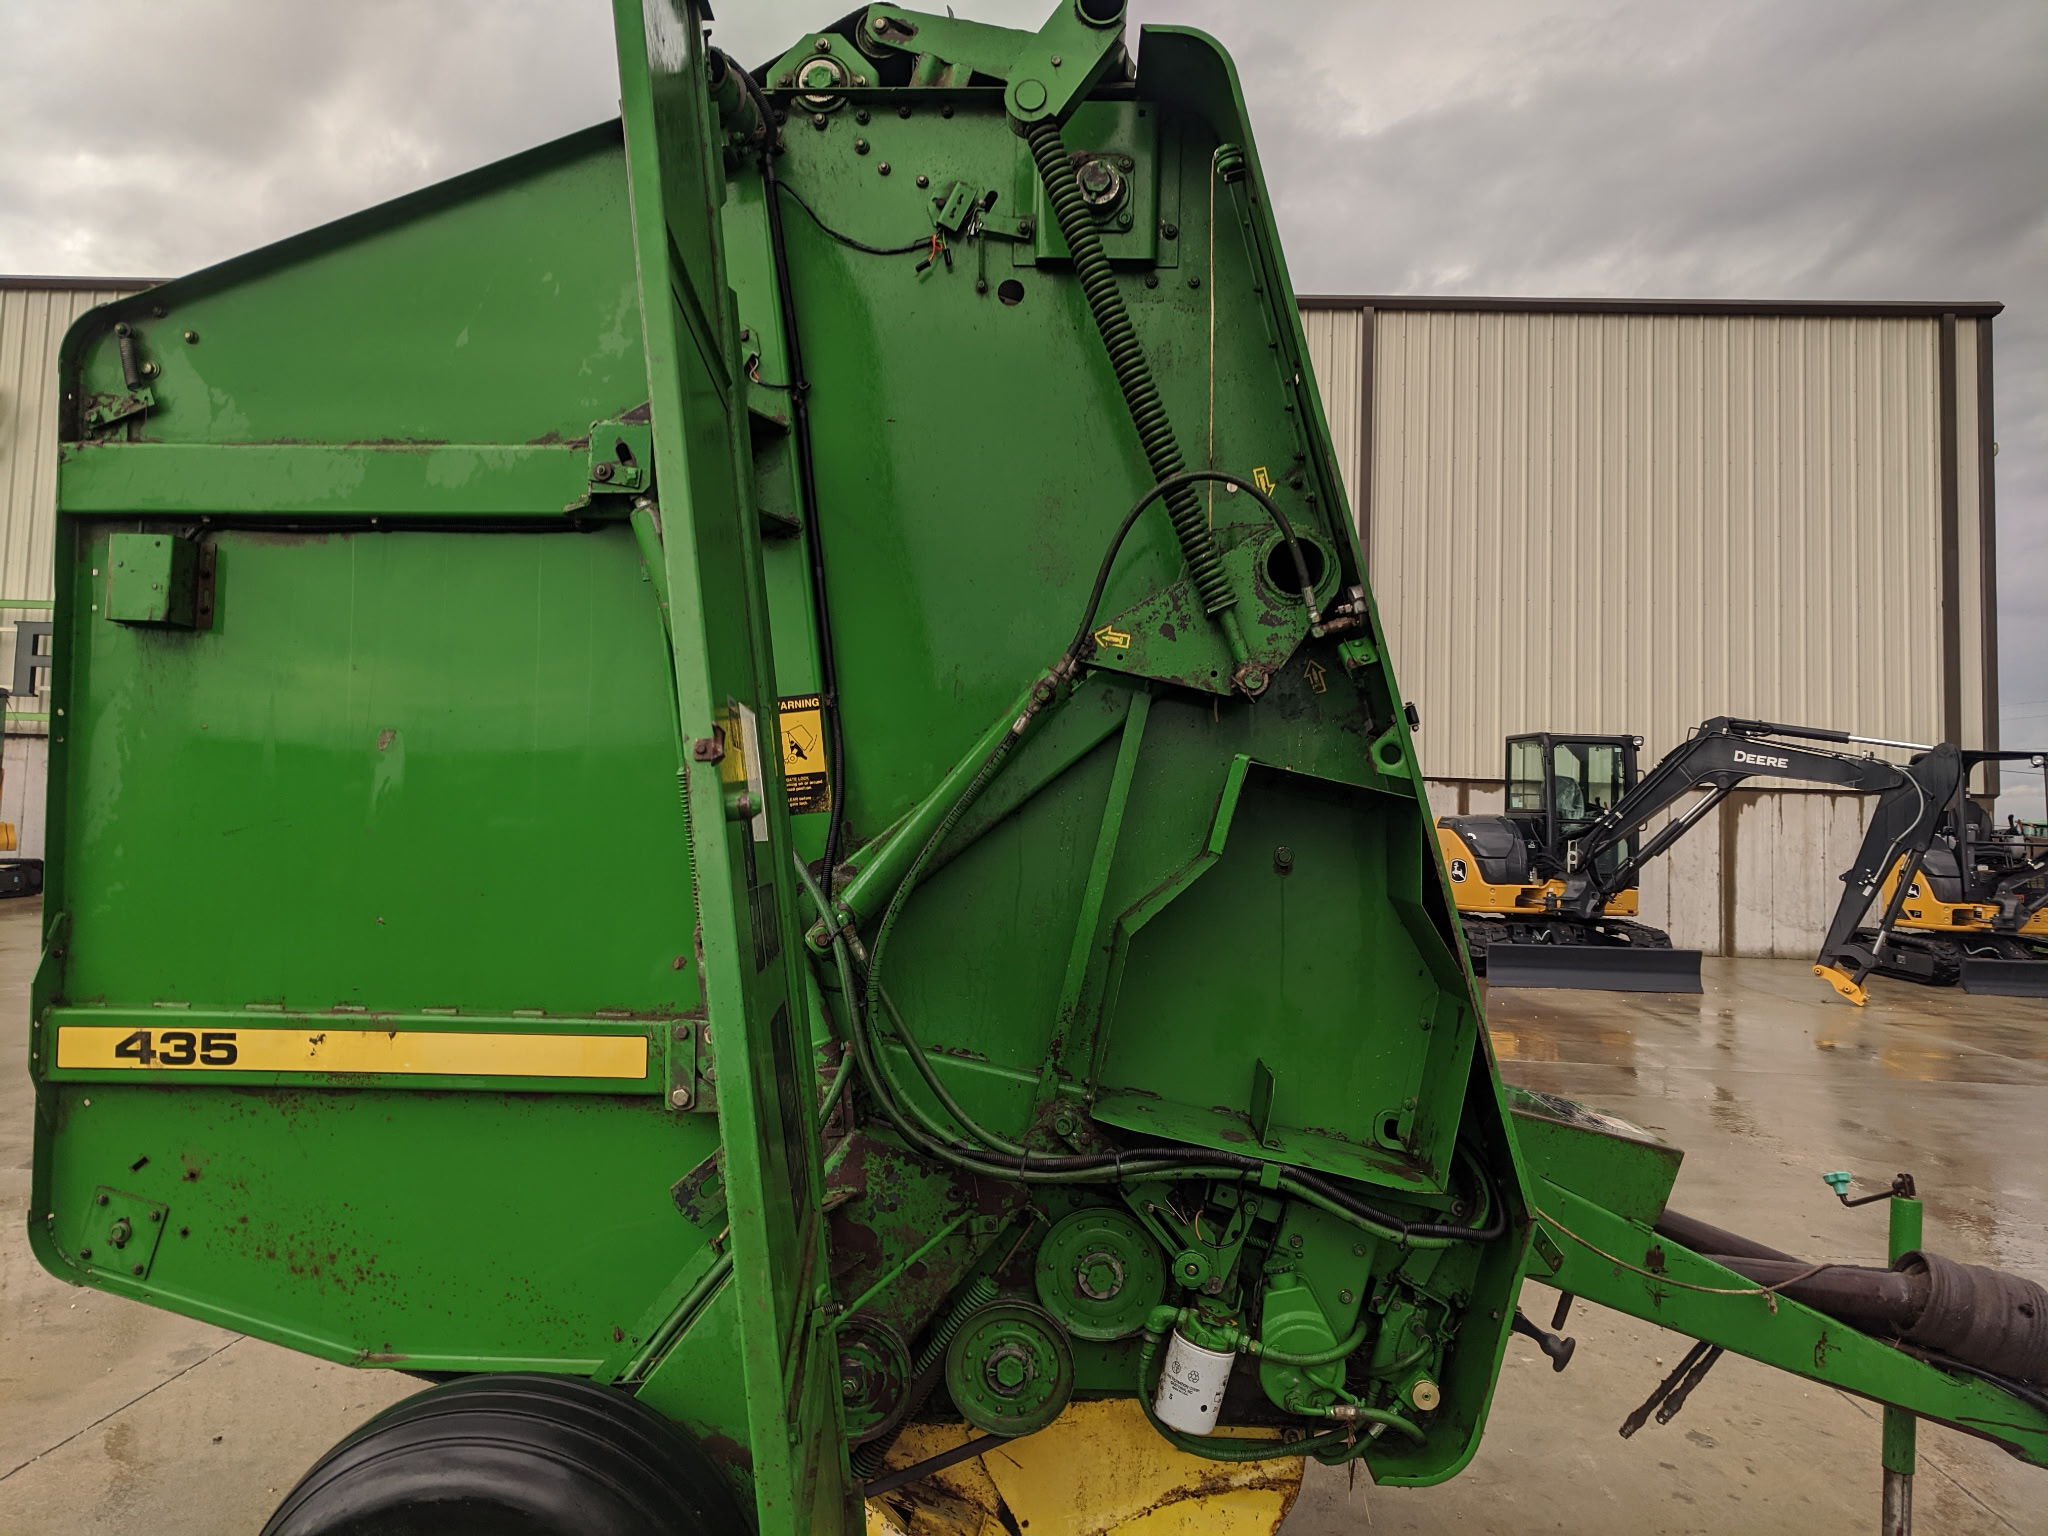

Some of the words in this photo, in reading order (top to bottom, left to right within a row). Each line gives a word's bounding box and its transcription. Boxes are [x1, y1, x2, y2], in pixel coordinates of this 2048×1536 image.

[777, 697, 820, 711] ARNING
[1733, 750, 1789, 769] DEERE
[115, 1031, 238, 1066] 435
